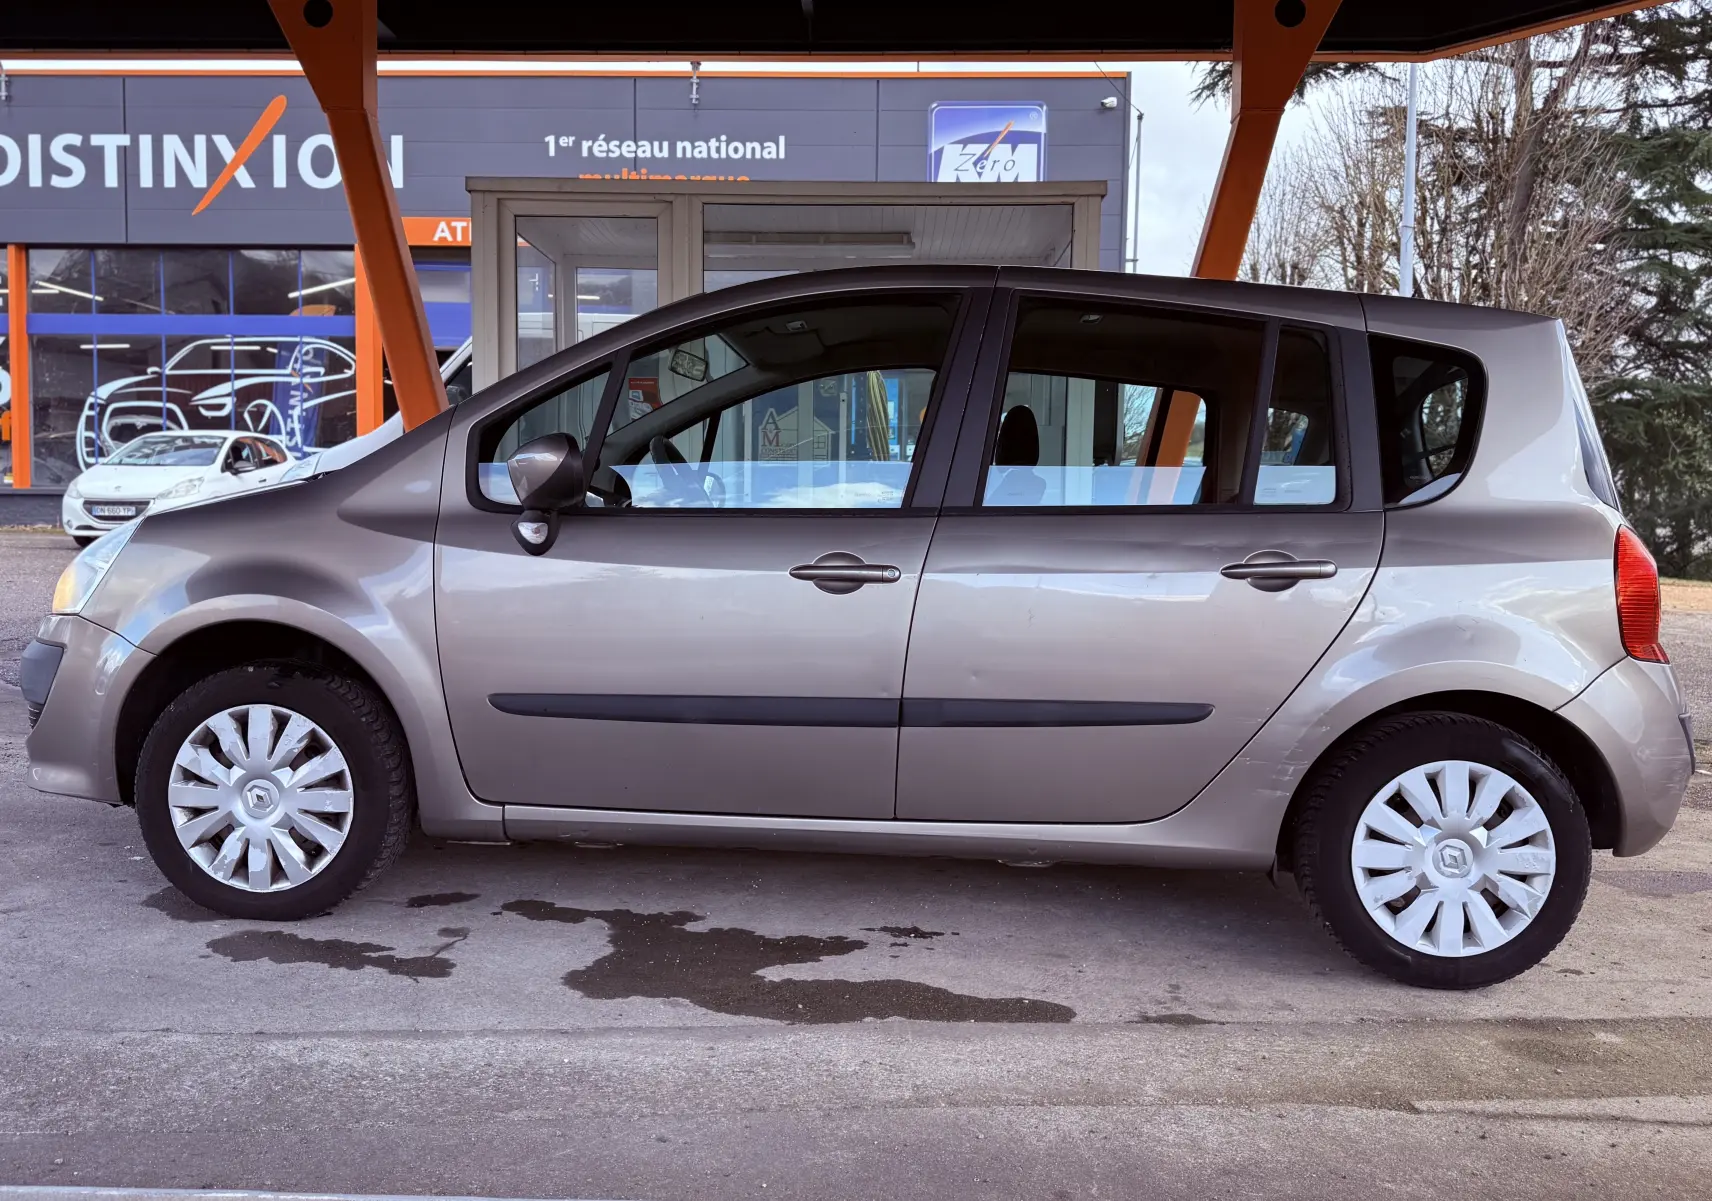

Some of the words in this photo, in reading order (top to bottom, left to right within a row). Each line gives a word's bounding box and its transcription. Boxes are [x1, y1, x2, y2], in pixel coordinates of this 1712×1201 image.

[581, 134, 668, 158] réseau
[676, 135, 786, 159] national
[432, 221, 472, 242] AT
